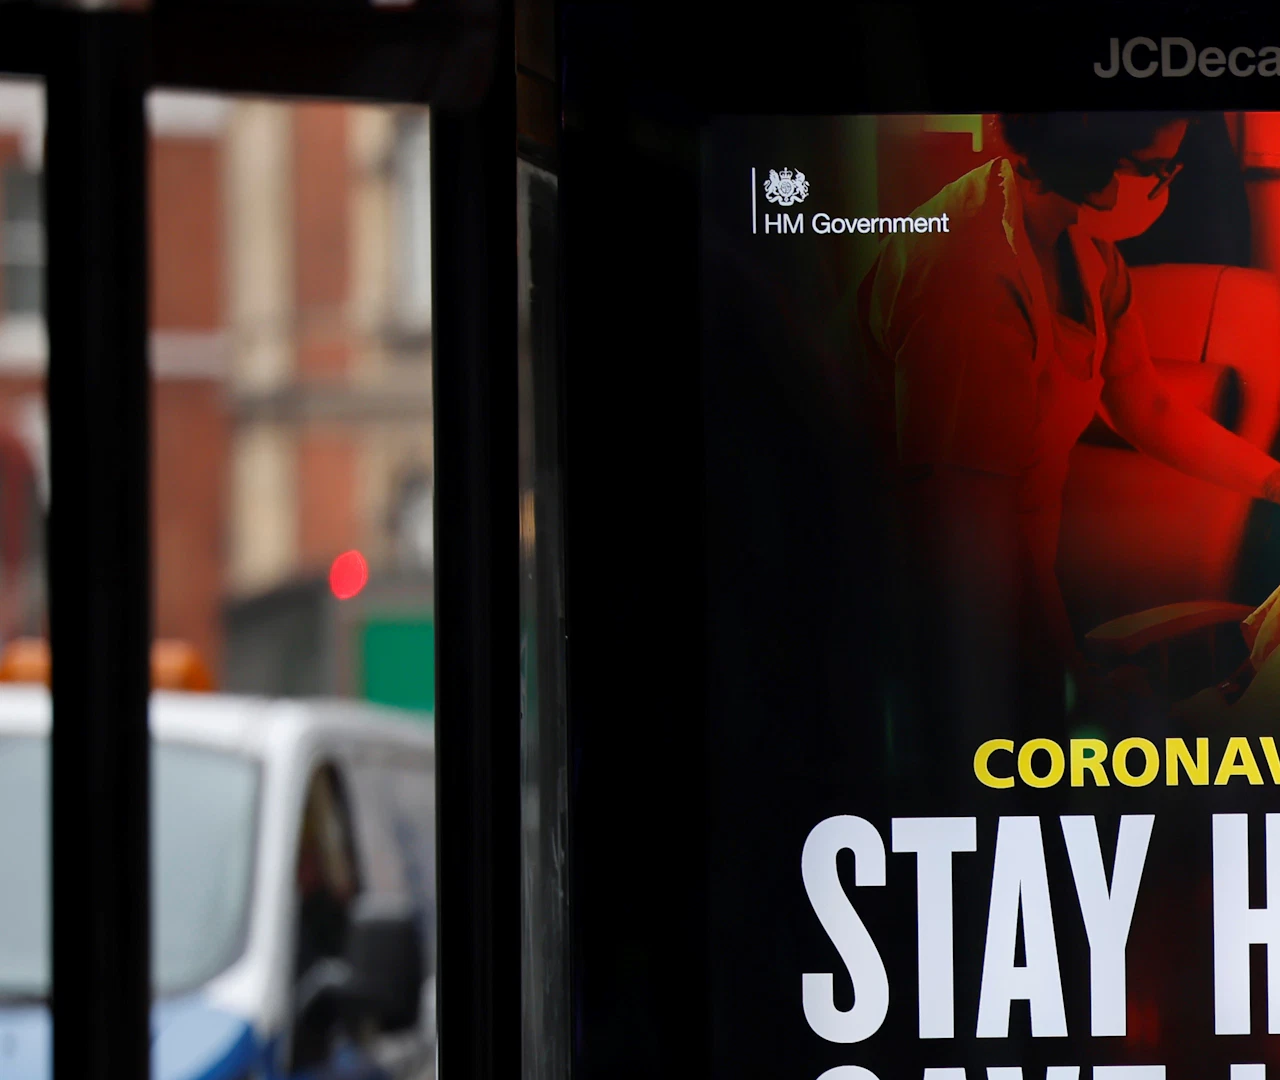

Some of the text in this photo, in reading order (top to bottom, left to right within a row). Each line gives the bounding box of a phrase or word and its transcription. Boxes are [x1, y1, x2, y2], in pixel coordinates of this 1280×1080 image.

[764, 212, 950, 236] HM Government
[802, 815, 1155, 1043] STAY
